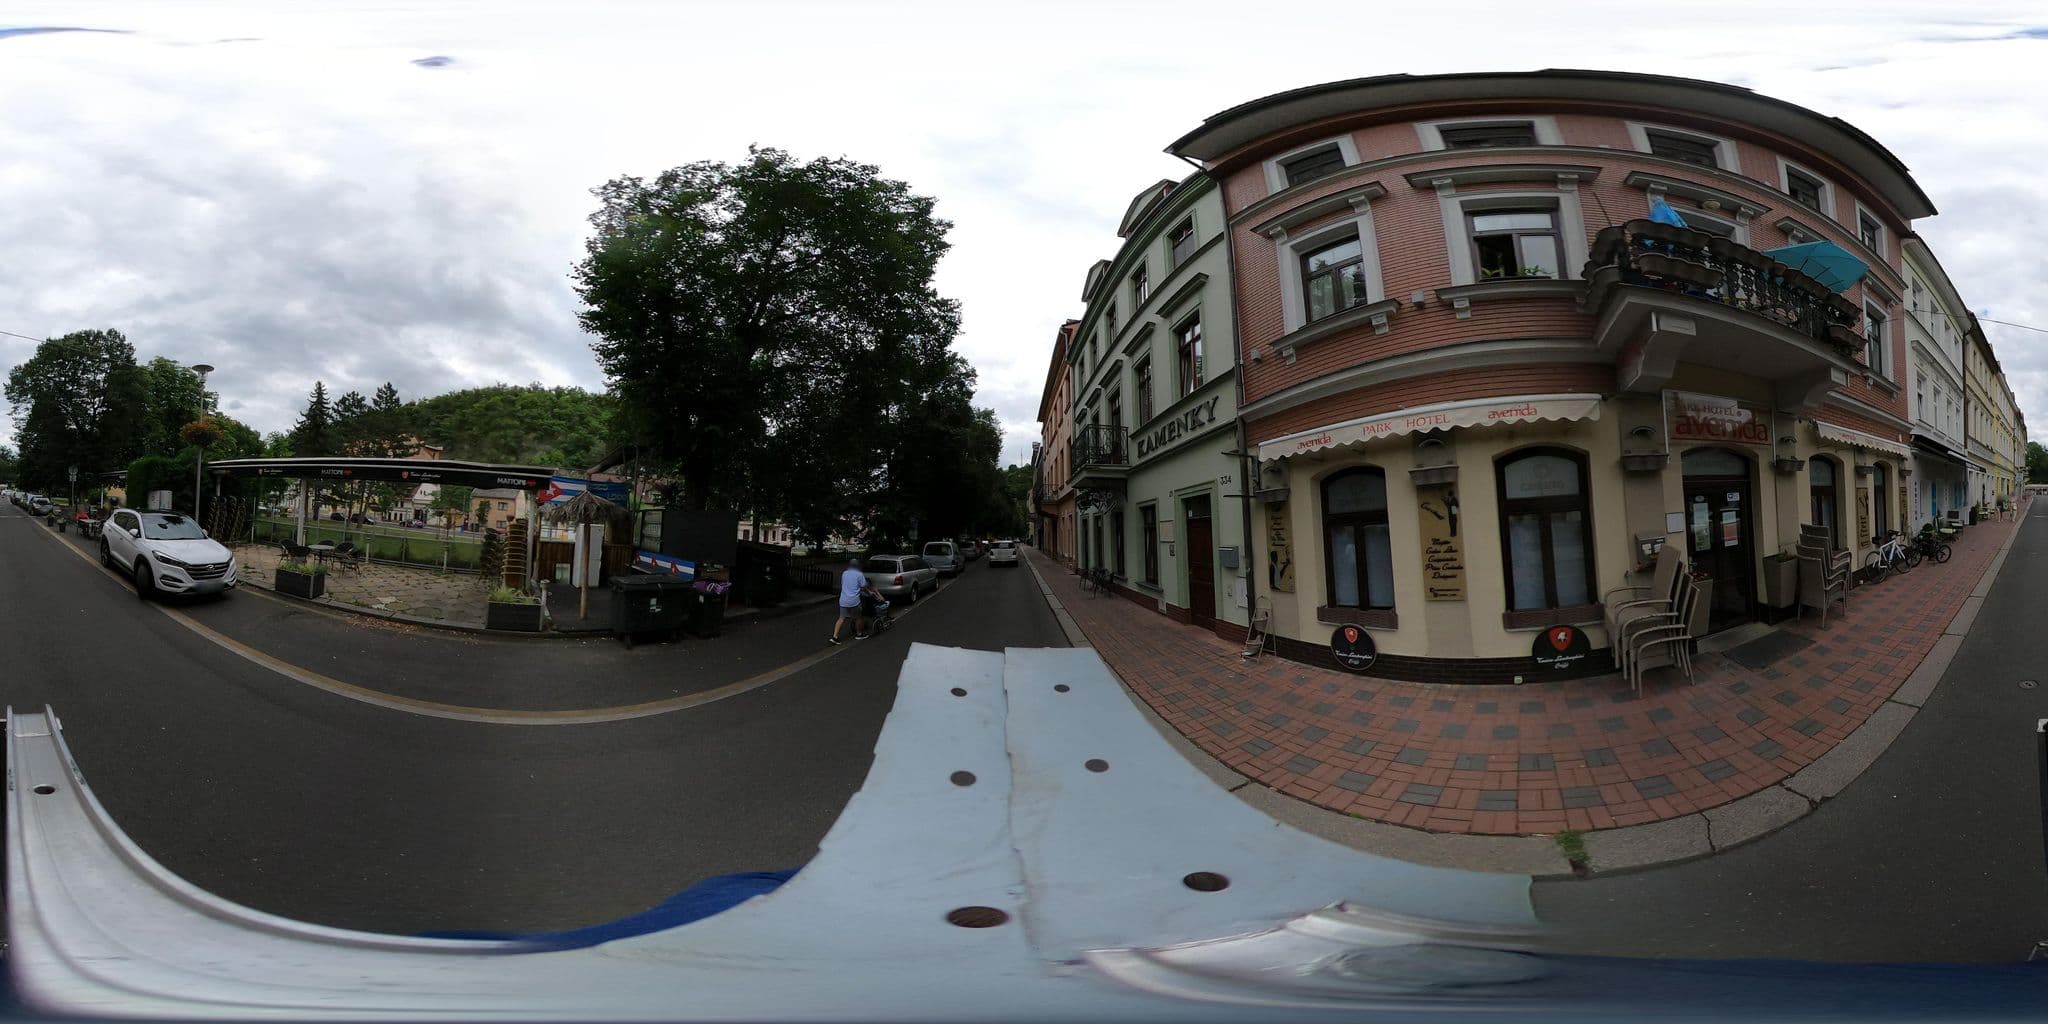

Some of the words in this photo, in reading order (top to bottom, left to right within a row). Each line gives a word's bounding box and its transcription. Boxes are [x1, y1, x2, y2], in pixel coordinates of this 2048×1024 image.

[1137, 396, 1219, 458] KAMENKY
[1297, 433, 1332, 450] avenida
[1362, 421, 1392, 436] PARK
[1406, 413, 1451, 428] HOTEL
[1487, 403, 1538, 420] avenida
[1703, 402, 1736, 416] HOTEL
[1674, 415, 1769, 442] avenida
